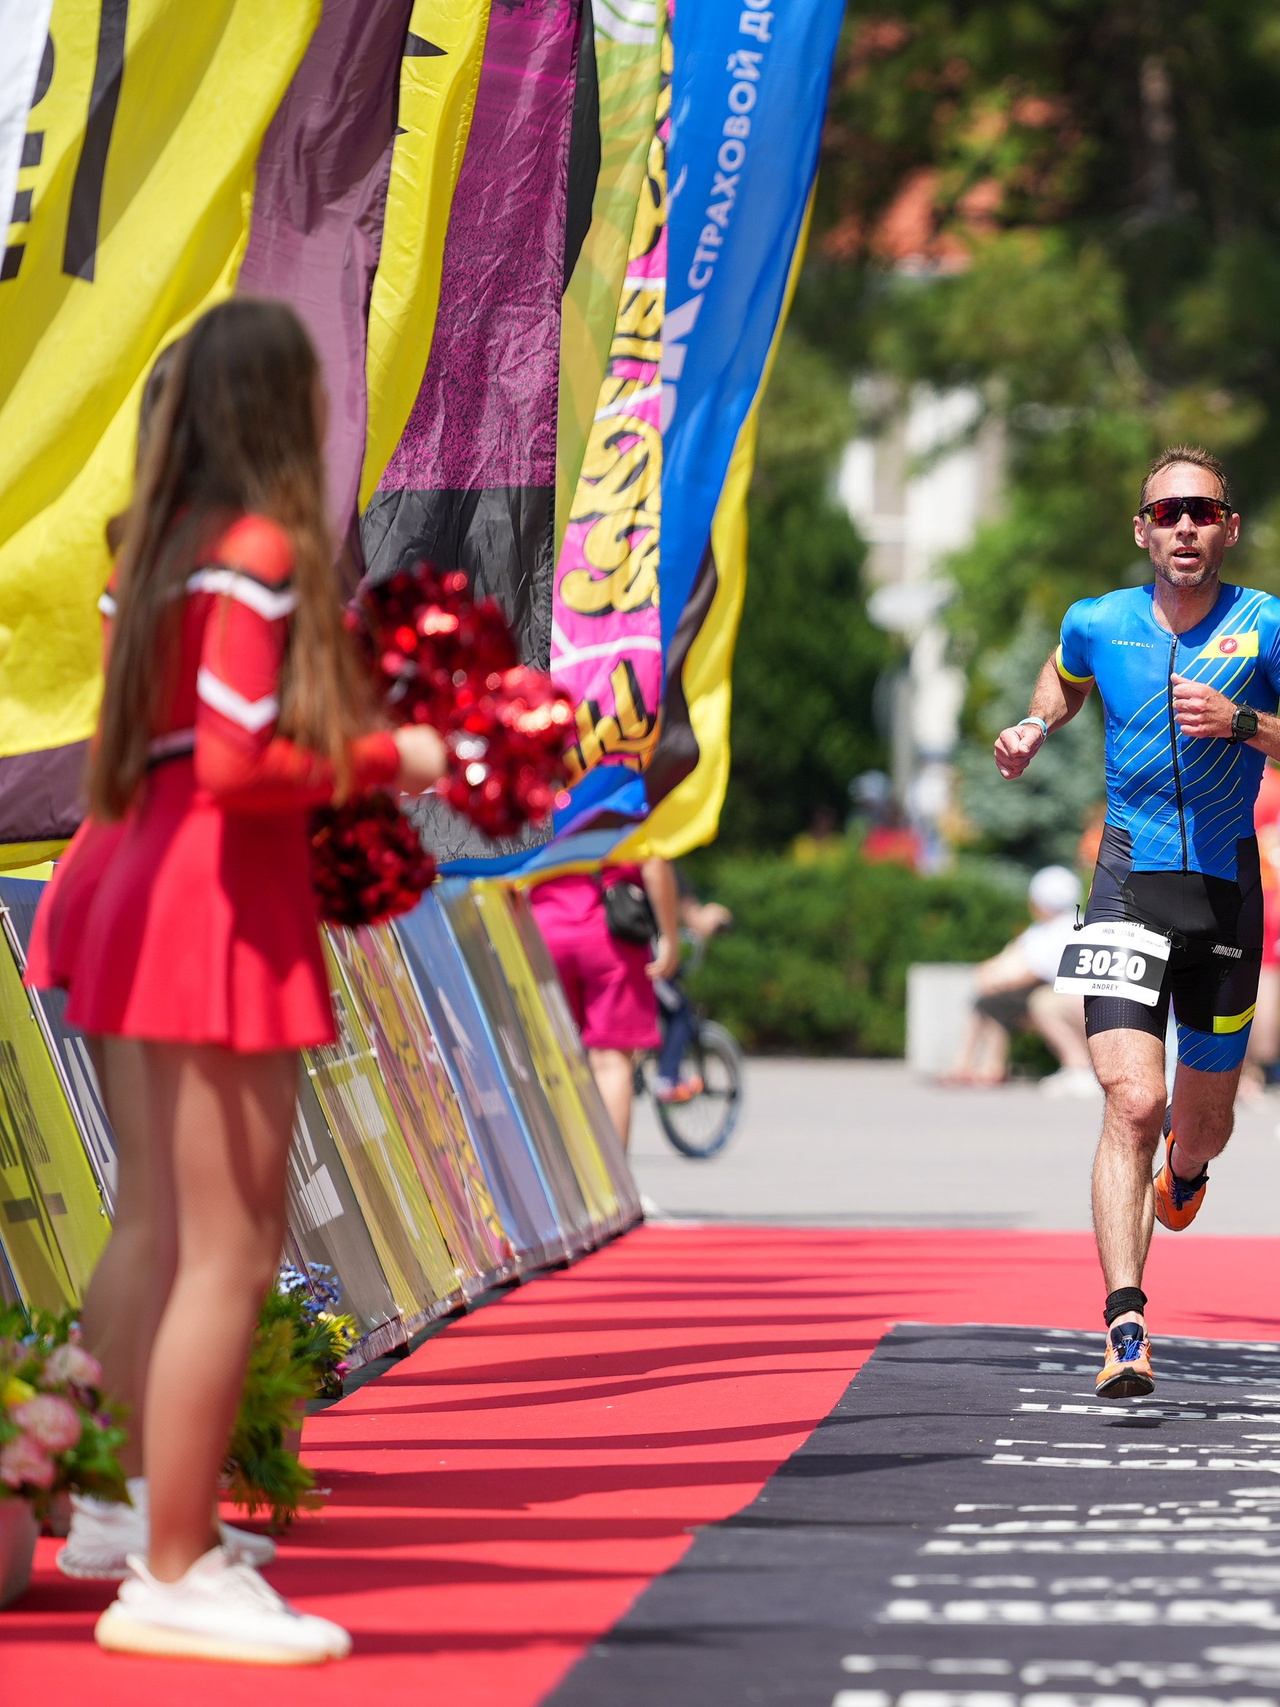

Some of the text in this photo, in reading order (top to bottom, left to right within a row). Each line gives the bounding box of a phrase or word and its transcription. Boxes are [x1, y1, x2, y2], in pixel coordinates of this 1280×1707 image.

[687, 49, 764, 291] СТРАХОВОЙ
[1212, 944, 1243, 959] IRONSTAR
[1075, 948, 1146, 982] 3020
[1091, 982, 1119, 992] ANDREY
